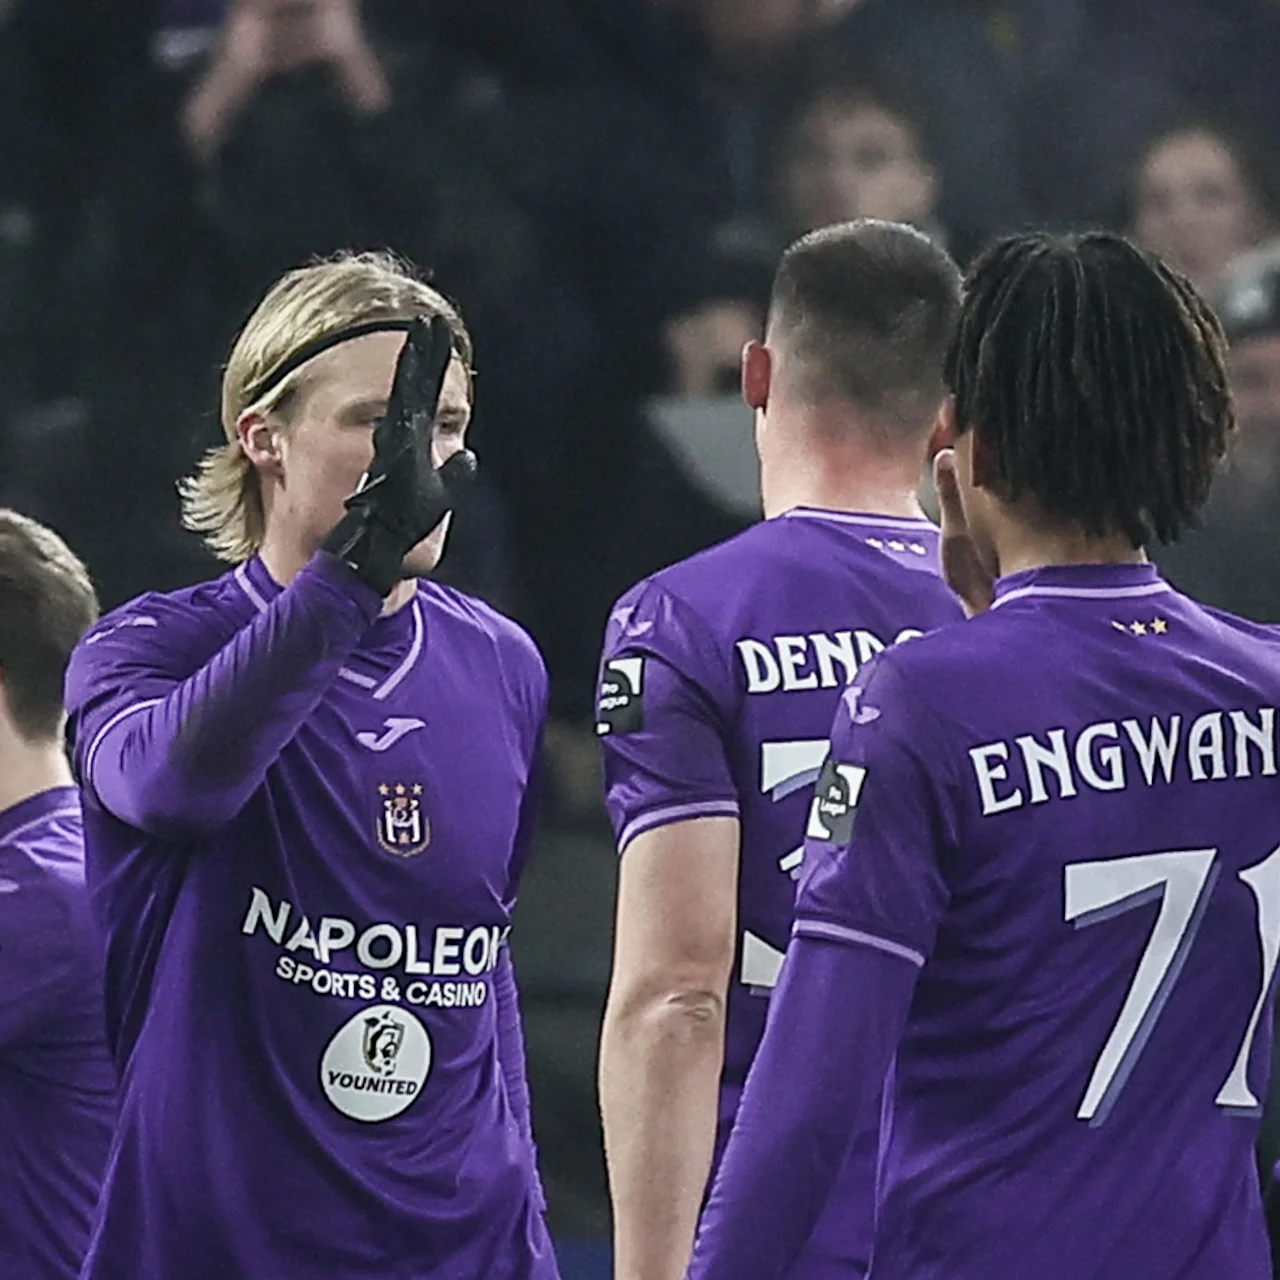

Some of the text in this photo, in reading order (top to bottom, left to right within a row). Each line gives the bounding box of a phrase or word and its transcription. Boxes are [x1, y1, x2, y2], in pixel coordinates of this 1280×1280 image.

[276, 957, 486, 1008] SPORTS & CASINO
[328, 1071, 418, 1096] YOUNITED
